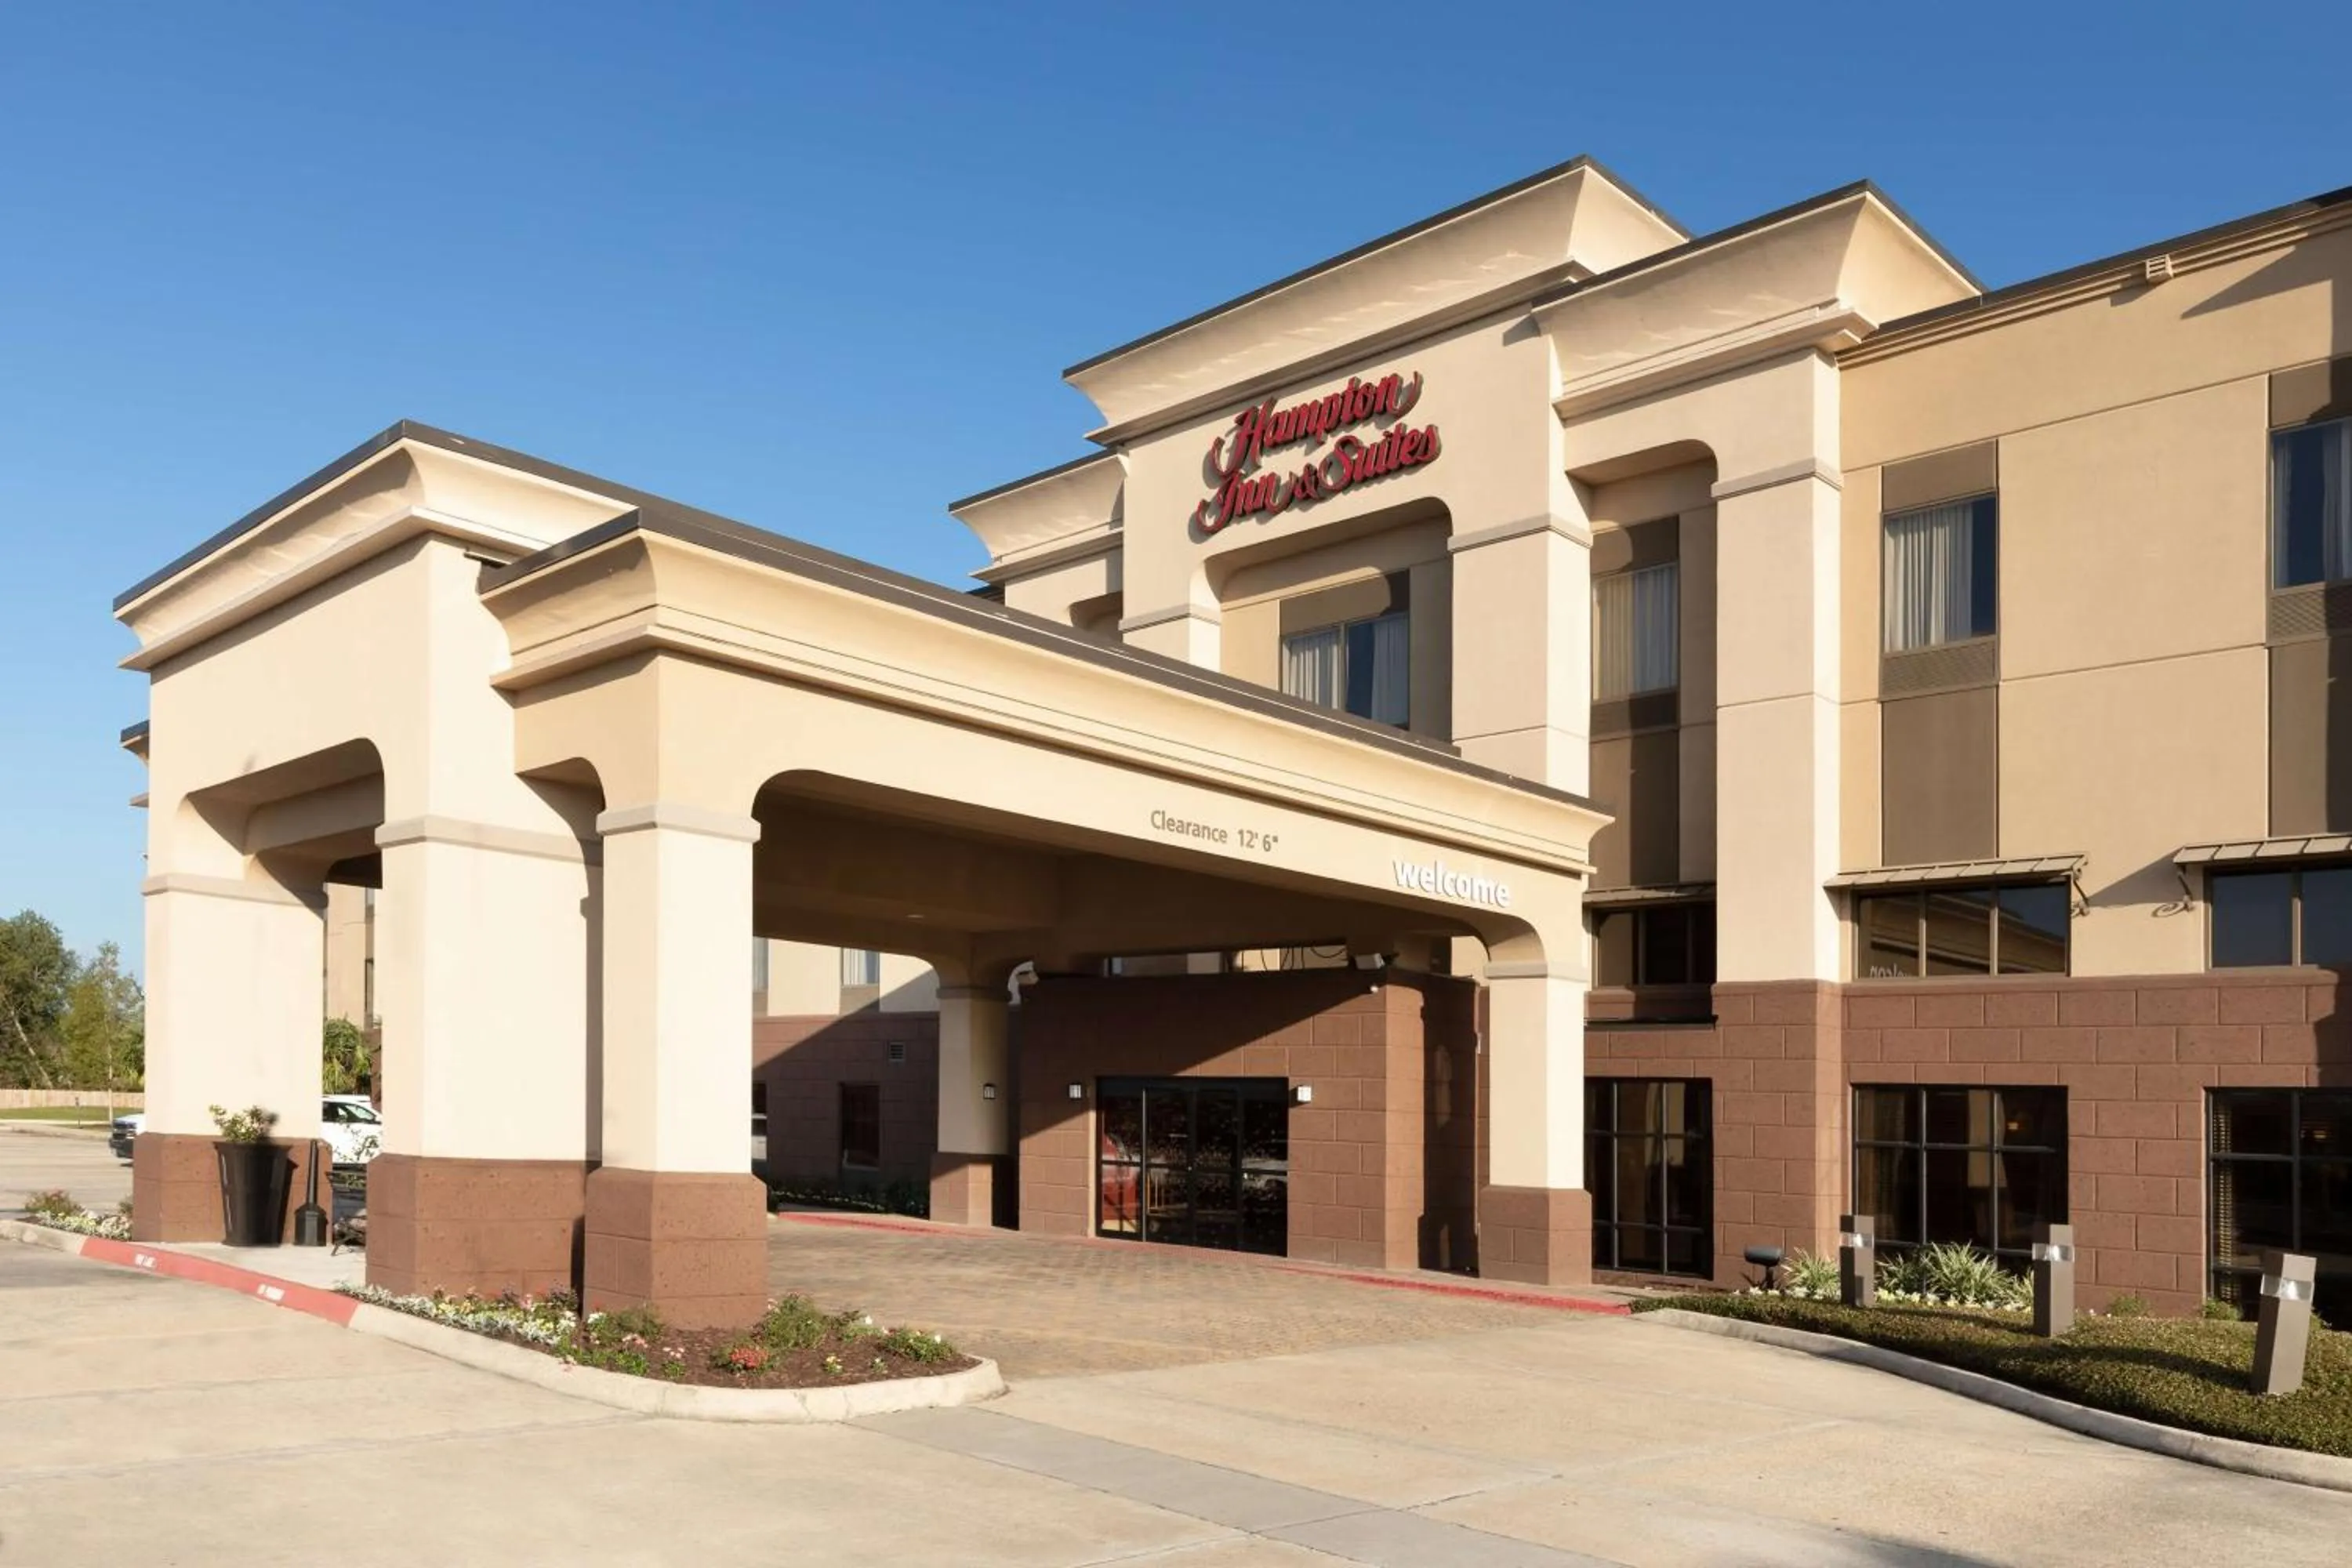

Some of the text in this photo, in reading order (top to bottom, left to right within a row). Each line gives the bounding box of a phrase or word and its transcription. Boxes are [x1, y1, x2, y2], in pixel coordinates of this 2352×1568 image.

[1210, 371, 1423, 476] Hampton
[1196, 423, 1440, 534] Inn & Suites
[1151, 810, 1228, 844] Clearance
[1392, 859, 1511, 908] welcome
